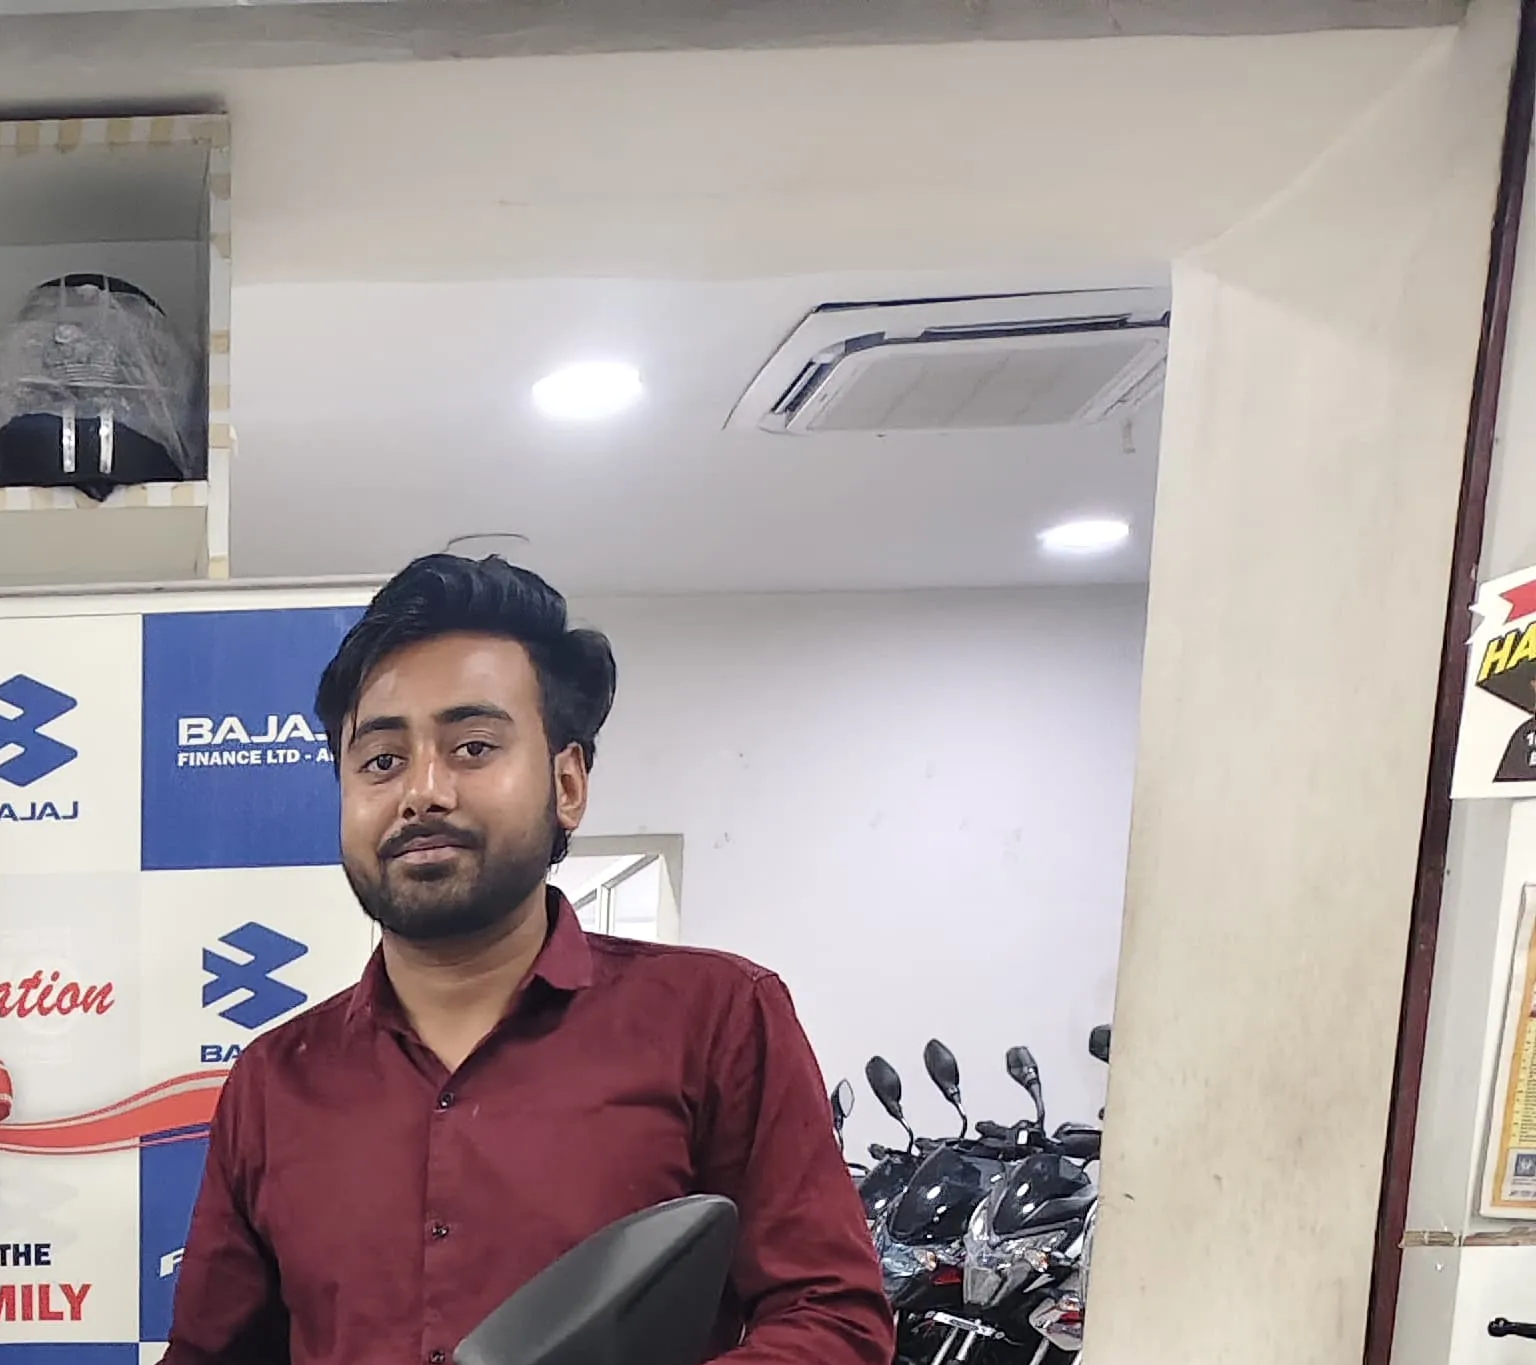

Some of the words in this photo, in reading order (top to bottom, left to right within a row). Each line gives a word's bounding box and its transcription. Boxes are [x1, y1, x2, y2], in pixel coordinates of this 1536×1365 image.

[178, 714, 328, 746] BAJA
[177, 750, 261, 767] FINANCE
[267, 748, 300, 764] LTD
